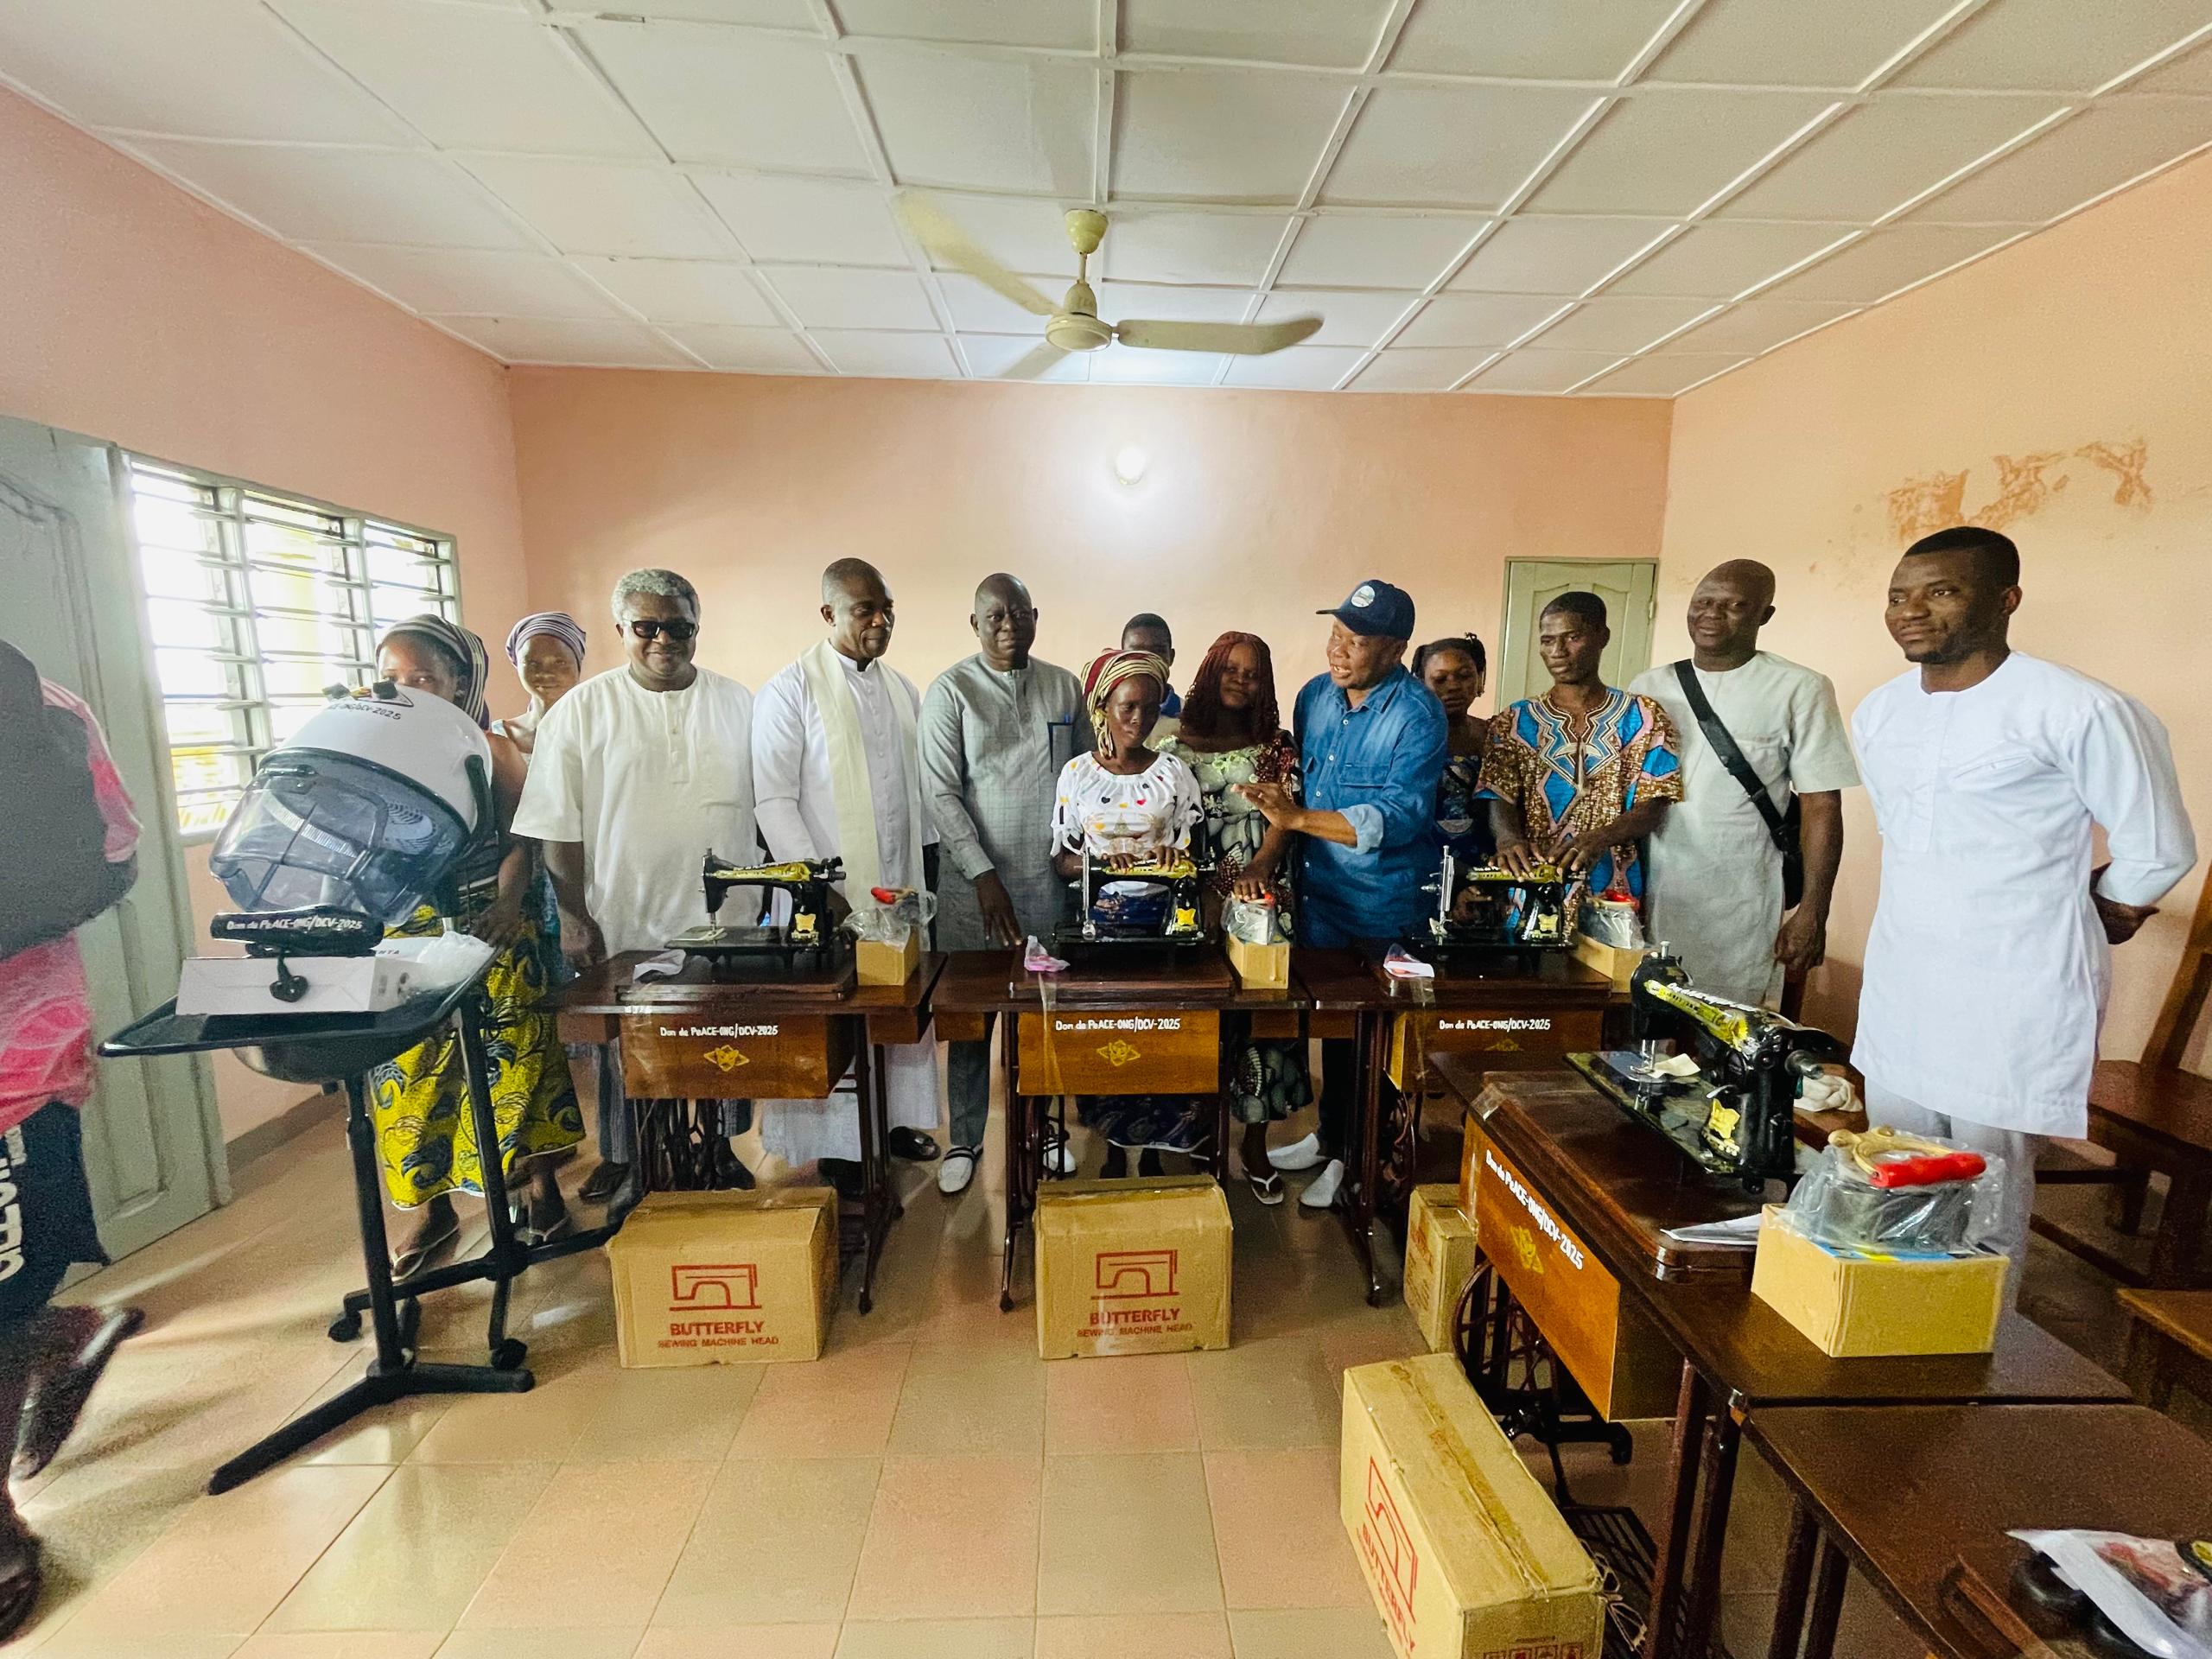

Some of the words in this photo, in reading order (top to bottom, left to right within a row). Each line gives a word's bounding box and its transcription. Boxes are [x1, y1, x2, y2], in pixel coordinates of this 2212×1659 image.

[1056, 1020, 1073, 1031] Don
[1439, 1020, 1454, 1029] Don
[660, 1027, 677, 1037] Don
[1090, 1308, 1180, 1326] BUTTERFLY
[670, 1320, 764, 1337] BUTTERFLY
[658, 1339, 697, 1349] SEWING
[702, 1338, 747, 1347] MACHINE
[751, 1336, 779, 1345] HEAD
